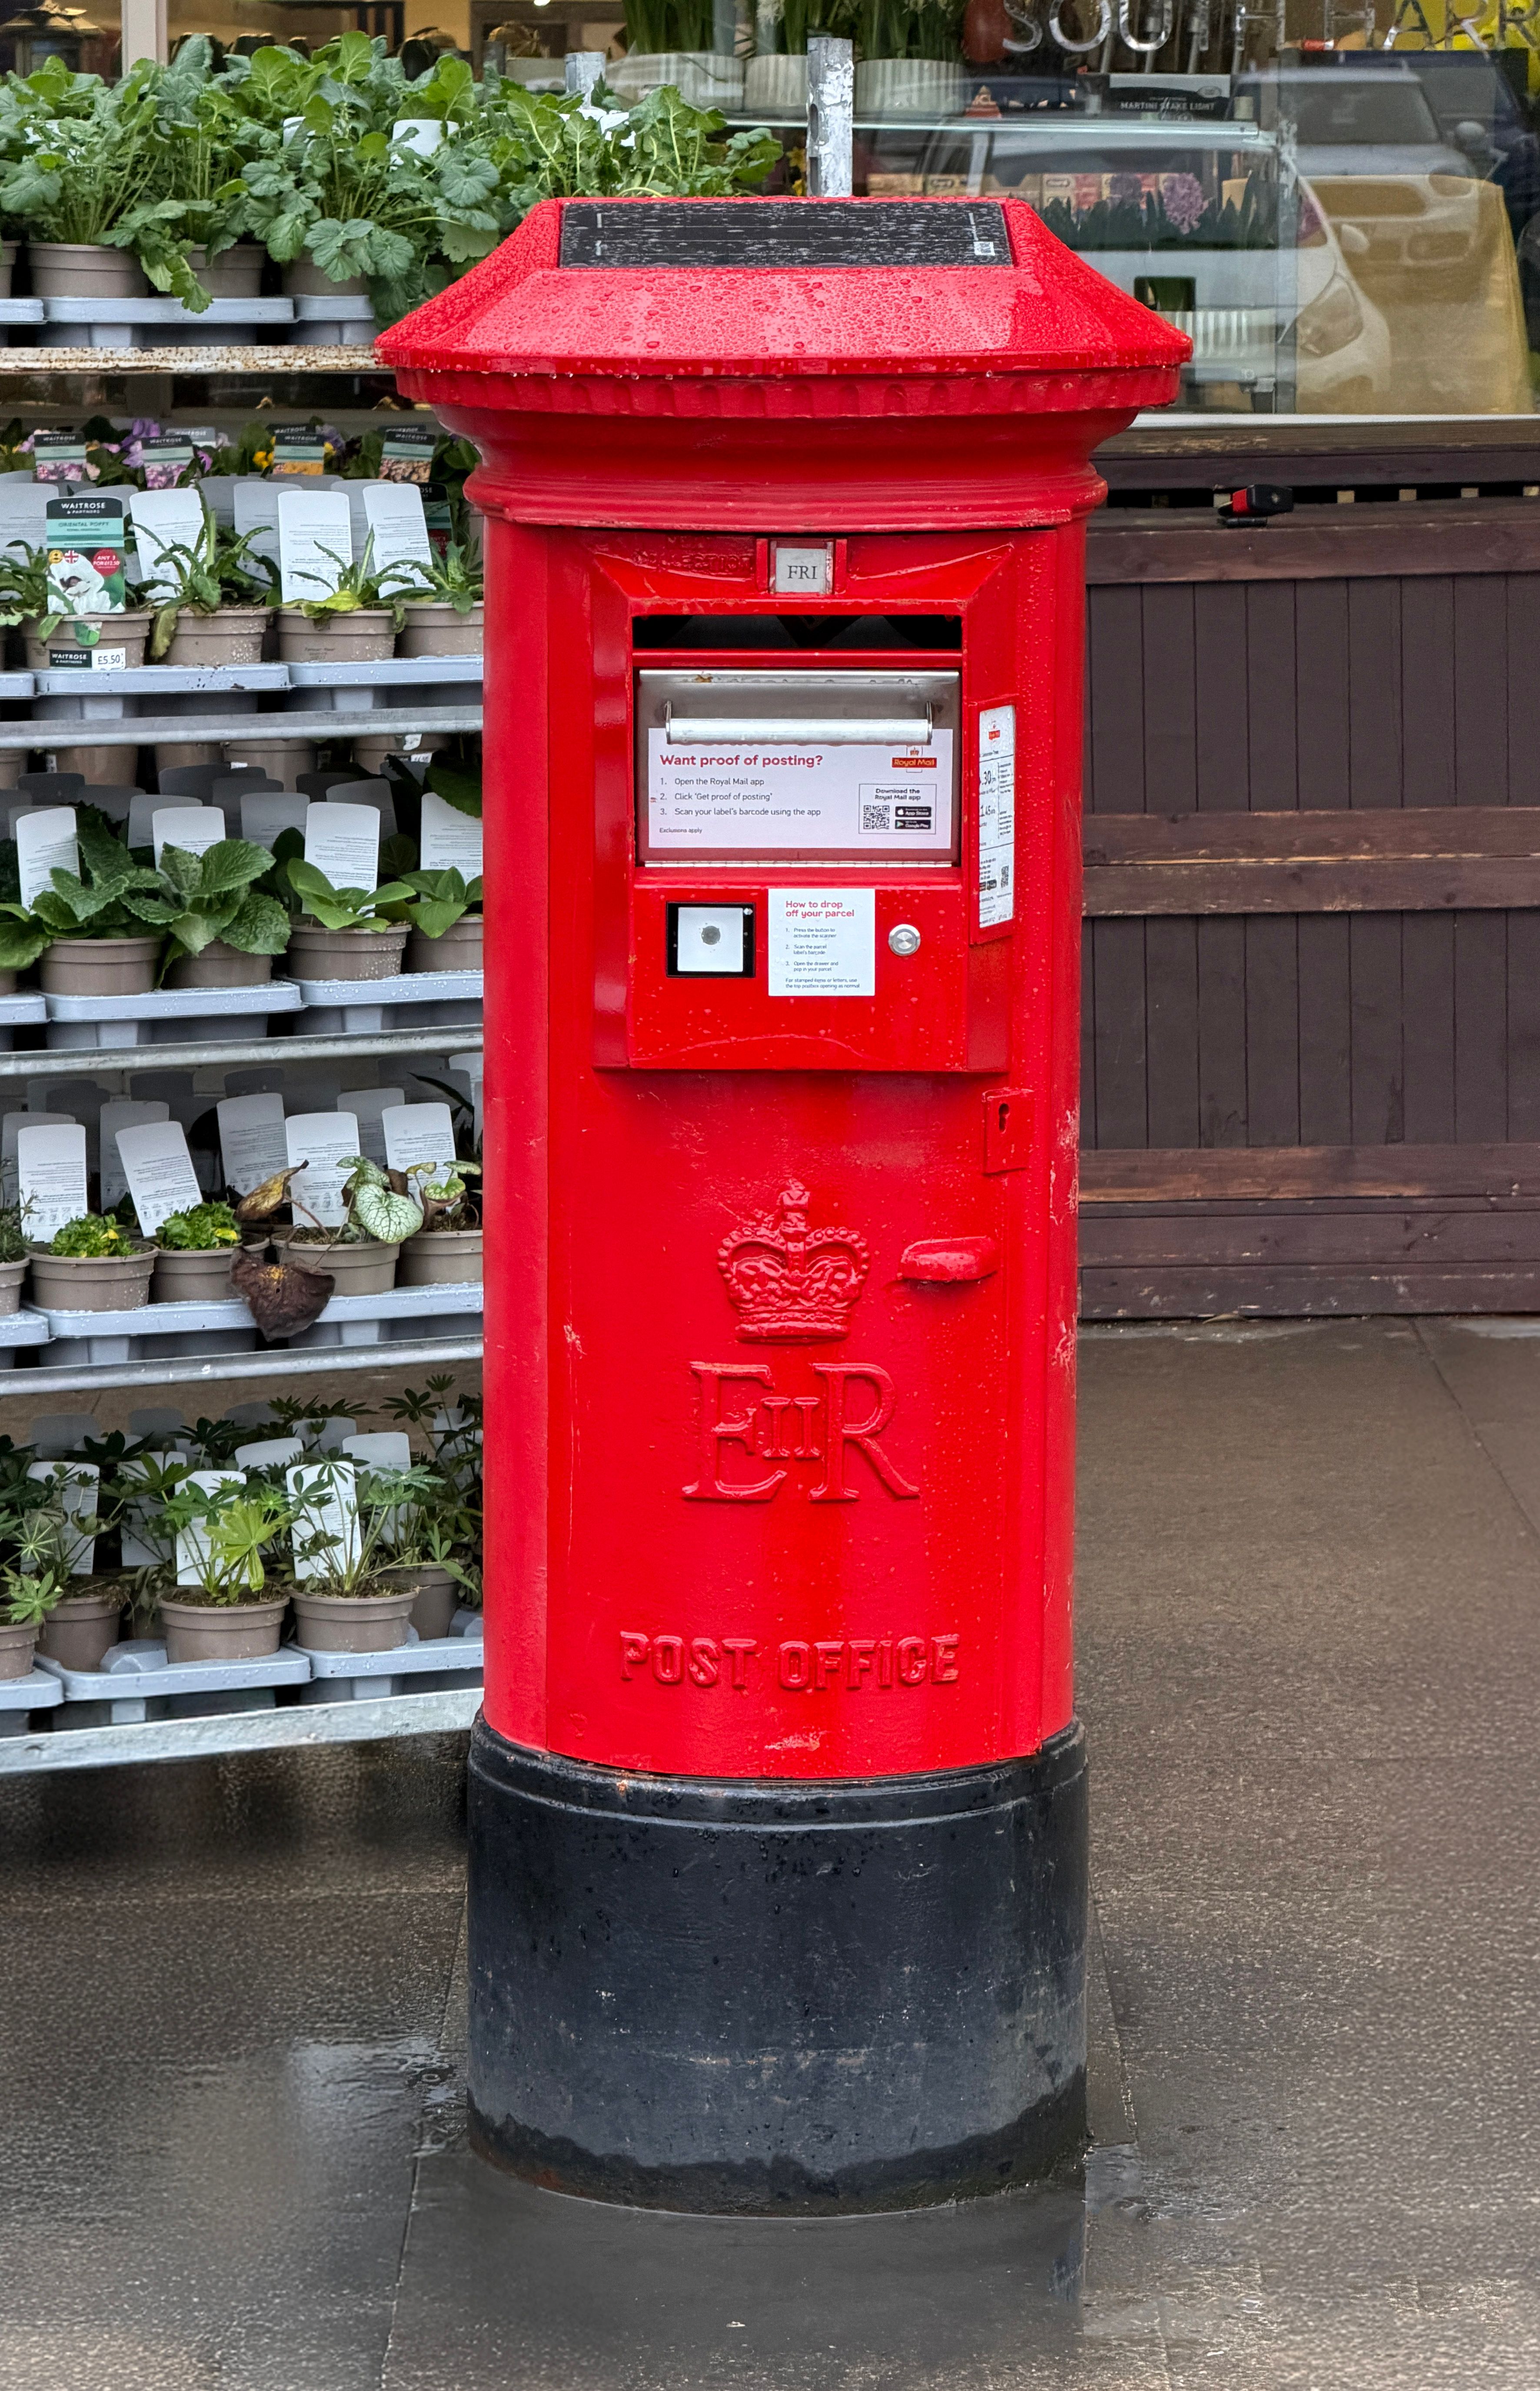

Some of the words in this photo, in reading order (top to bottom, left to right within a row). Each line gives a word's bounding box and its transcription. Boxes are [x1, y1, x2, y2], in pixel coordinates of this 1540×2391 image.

[787, 565, 817, 579] FRI
[98, 655, 120, 664] £5.50
[660, 755, 696, 765] Want
[700, 755, 740, 767] proof
[744, 755, 758, 765] of
[762, 755, 823, 768] posting?
[675, 778, 694, 786] Open
[710, 777, 730, 786] Royal
[712, 793, 731, 801] proof
[771, 808, 791, 816] using
[821, 900, 843, 909] drop
[825, 909, 854, 919] parcel
[619, 1630, 758, 1690] POST
[779, 1633, 961, 1691] OFFICE
